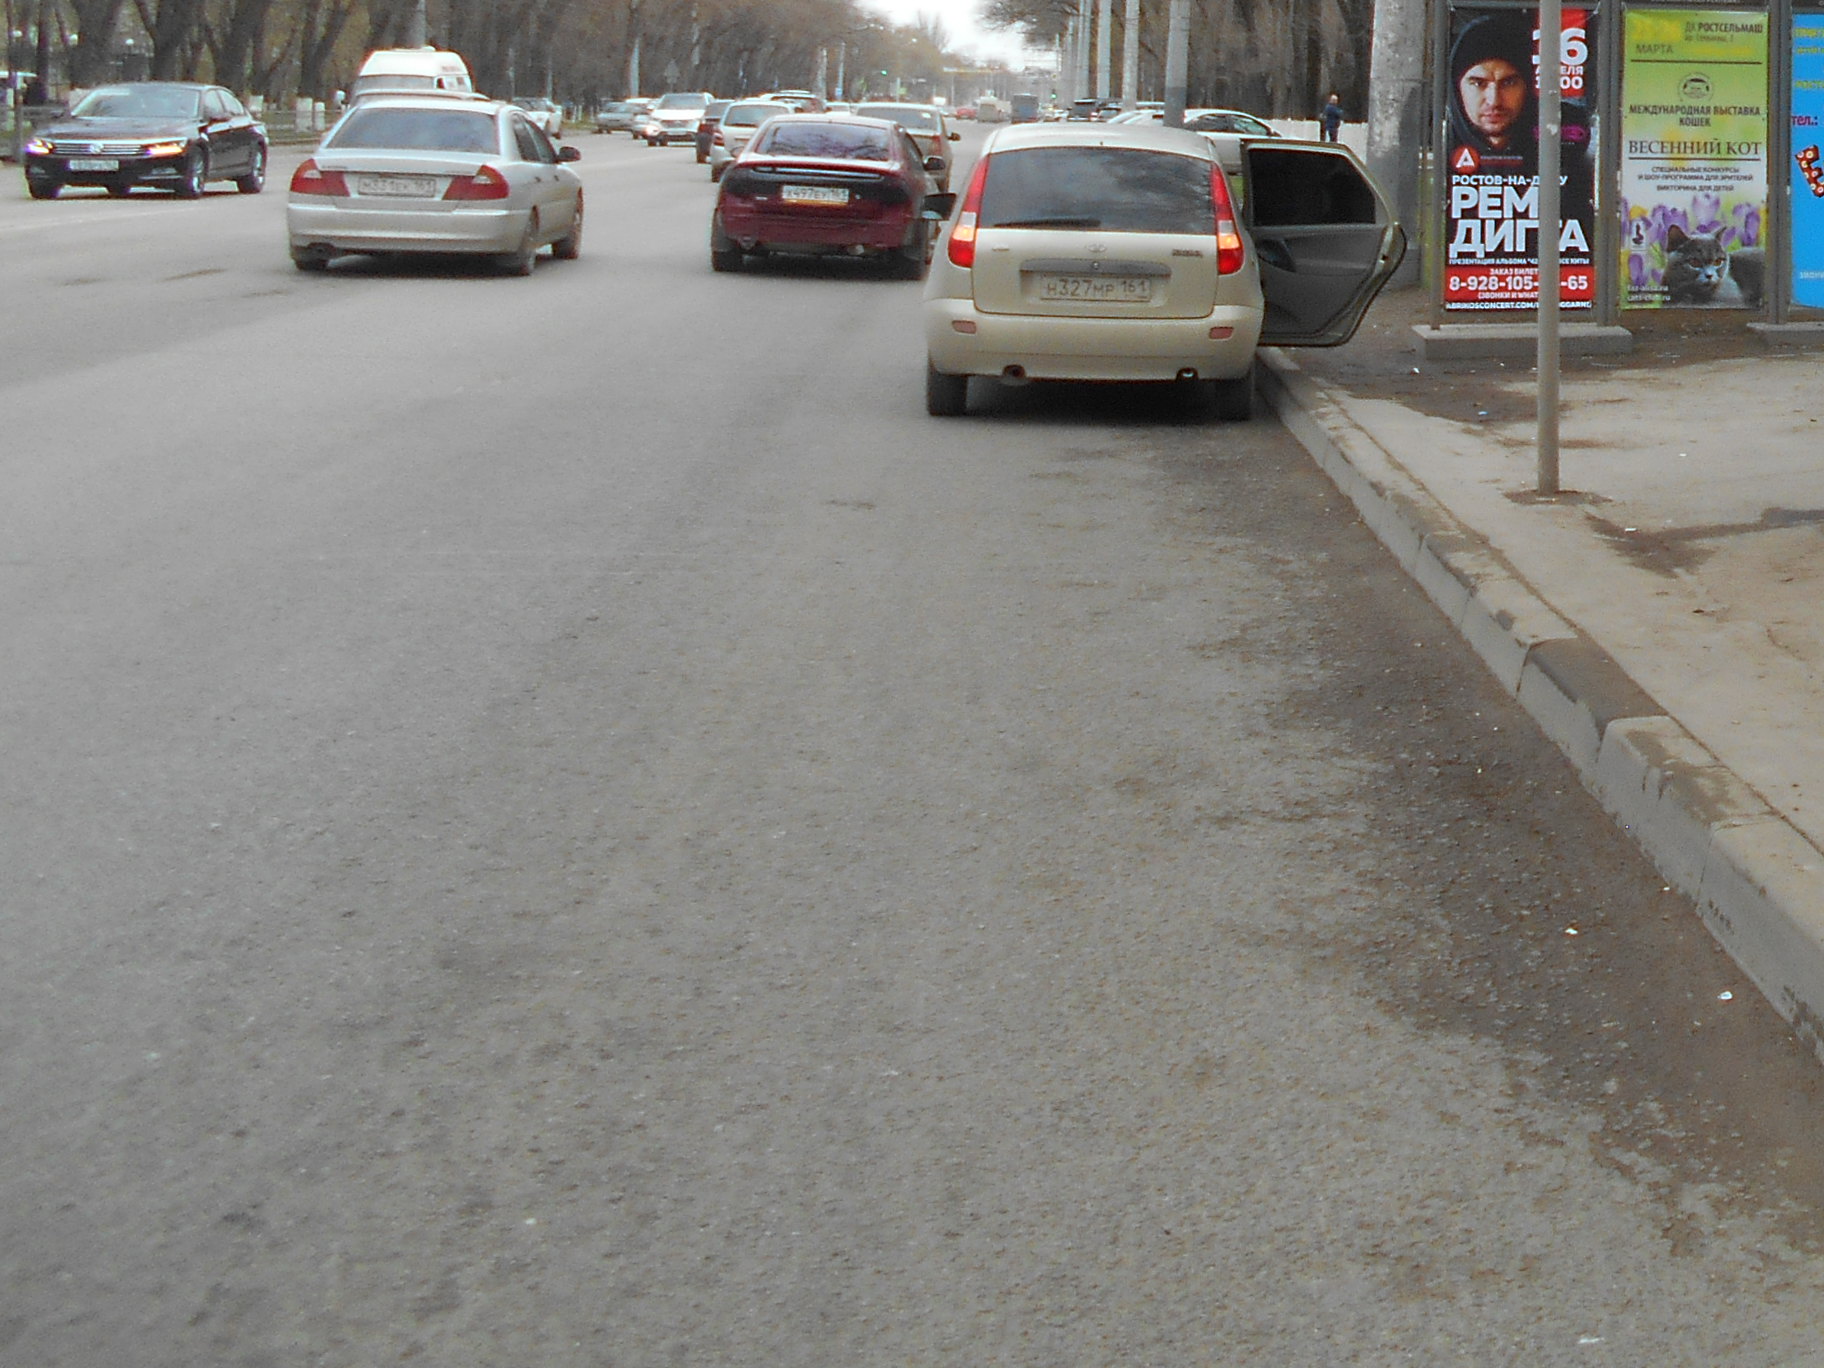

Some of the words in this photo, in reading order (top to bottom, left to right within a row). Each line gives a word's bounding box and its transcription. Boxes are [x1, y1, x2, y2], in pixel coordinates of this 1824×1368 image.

[1698, 22, 1763, 34] РОСТСЕЛЬМАШ
[1636, 44, 1673, 53] МАРТА
[1629, 104, 1711, 115] МЕЖДУНАРОДНАЯ
[1713, 106, 1760, 115] ВЫСТАВКА
[1679, 117, 1711, 127] КОШЕК
[1791, 115, 1818, 127] тел.:
[1628, 138, 1721, 155] ВЕСЕННИЙ
[1726, 141, 1762, 155] КОТ
[1452, 175, 1568, 186] РОСТОВ-НА-ДУ
[1451, 185, 1539, 219] РЕМ
[1449, 219, 1590, 259] ДИГА
[1047, 279, 1114, 297] Н327МР
[1123, 280, 1147, 292] 161
[1449, 275, 1588, 291] 8-928-105--65
